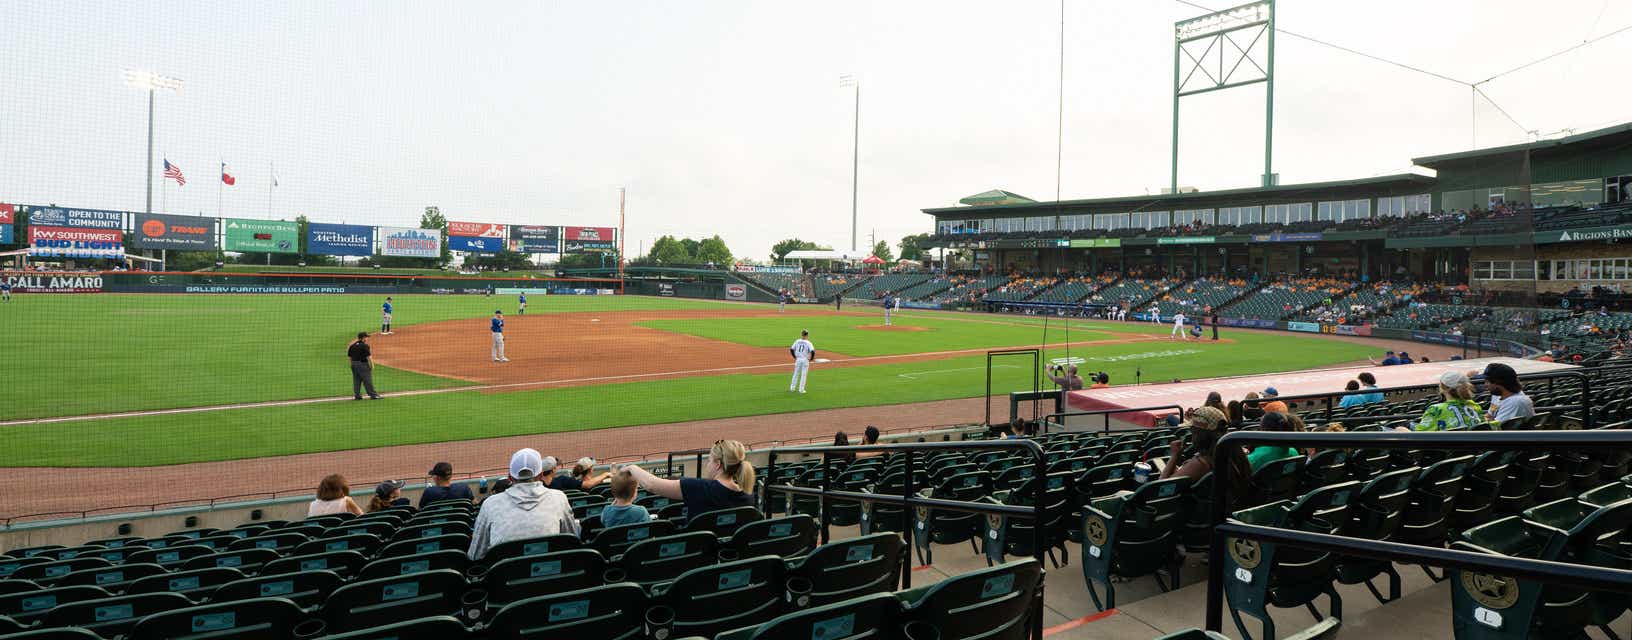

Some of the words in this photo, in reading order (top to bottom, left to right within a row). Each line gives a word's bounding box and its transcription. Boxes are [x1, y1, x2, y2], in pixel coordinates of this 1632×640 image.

[69, 210, 91, 219] OPEN
[106, 212, 121, 220] THE
[69, 219, 120, 228] COMMUNITY
[33, 227, 56, 239] kw
[57, 231, 117, 241] SOUTHWEST
[313, 233, 368, 244] Methodist
[1573, 231, 1612, 240] REGIONS
[1613, 229, 1632, 238] BAN
[35, 238, 72, 248] BUD
[75, 240, 121, 250] LIGHT
[8, 276, 46, 289] CALL
[49, 277, 103, 290] AMARO
